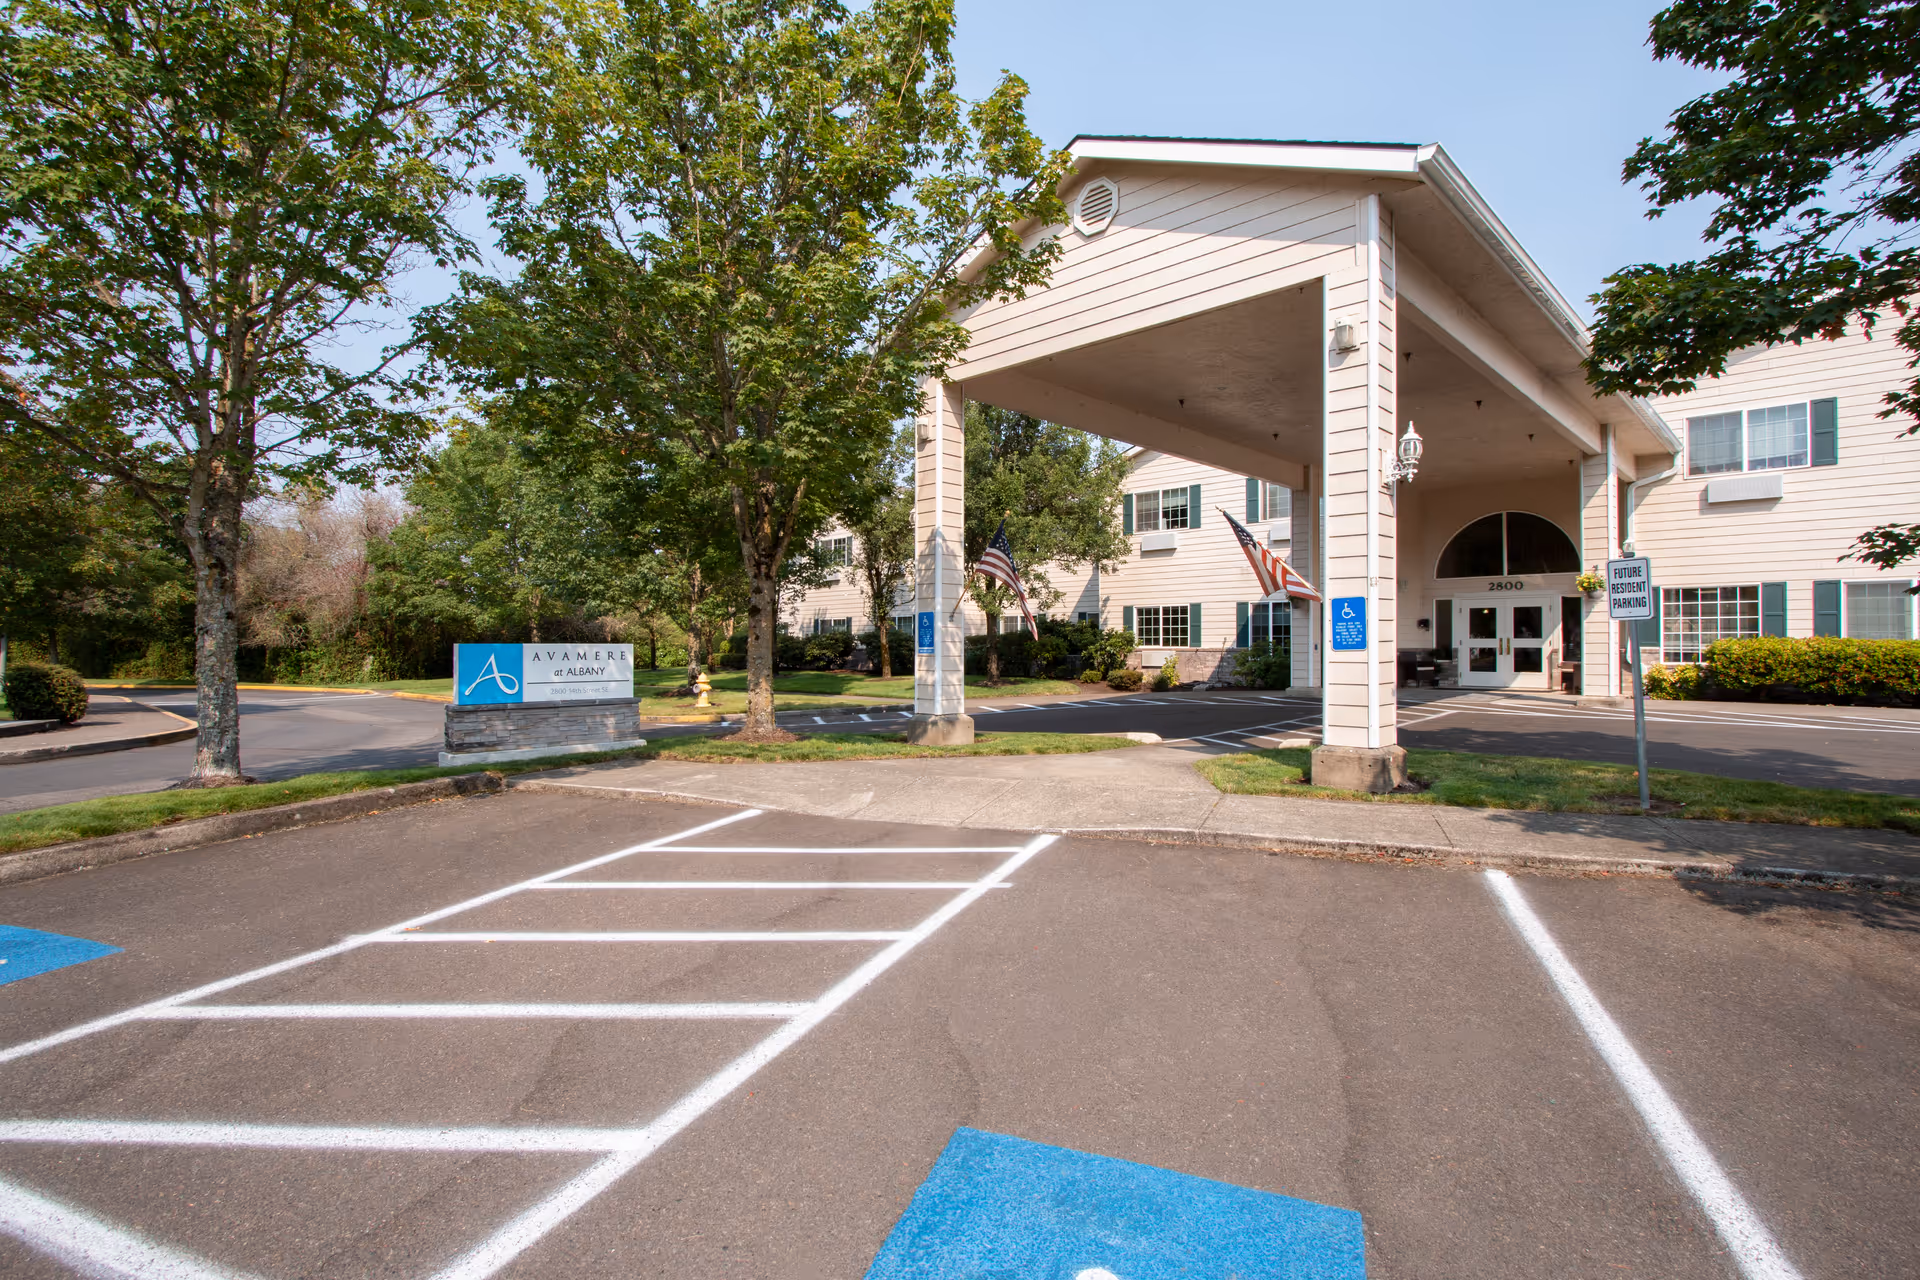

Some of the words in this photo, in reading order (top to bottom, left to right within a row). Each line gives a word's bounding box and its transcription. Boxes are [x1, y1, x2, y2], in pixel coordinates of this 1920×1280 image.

[1613, 566, 1642, 579] FUTURE
[1488, 581, 1524, 591] 2800
[1611, 581, 1646, 594] RESIDENT
[1612, 596, 1647, 609] PARKING
[532, 651, 627, 661] AVAMERE
[566, 667, 606, 676] ALBANY
[550, 687, 567, 695] 2800
